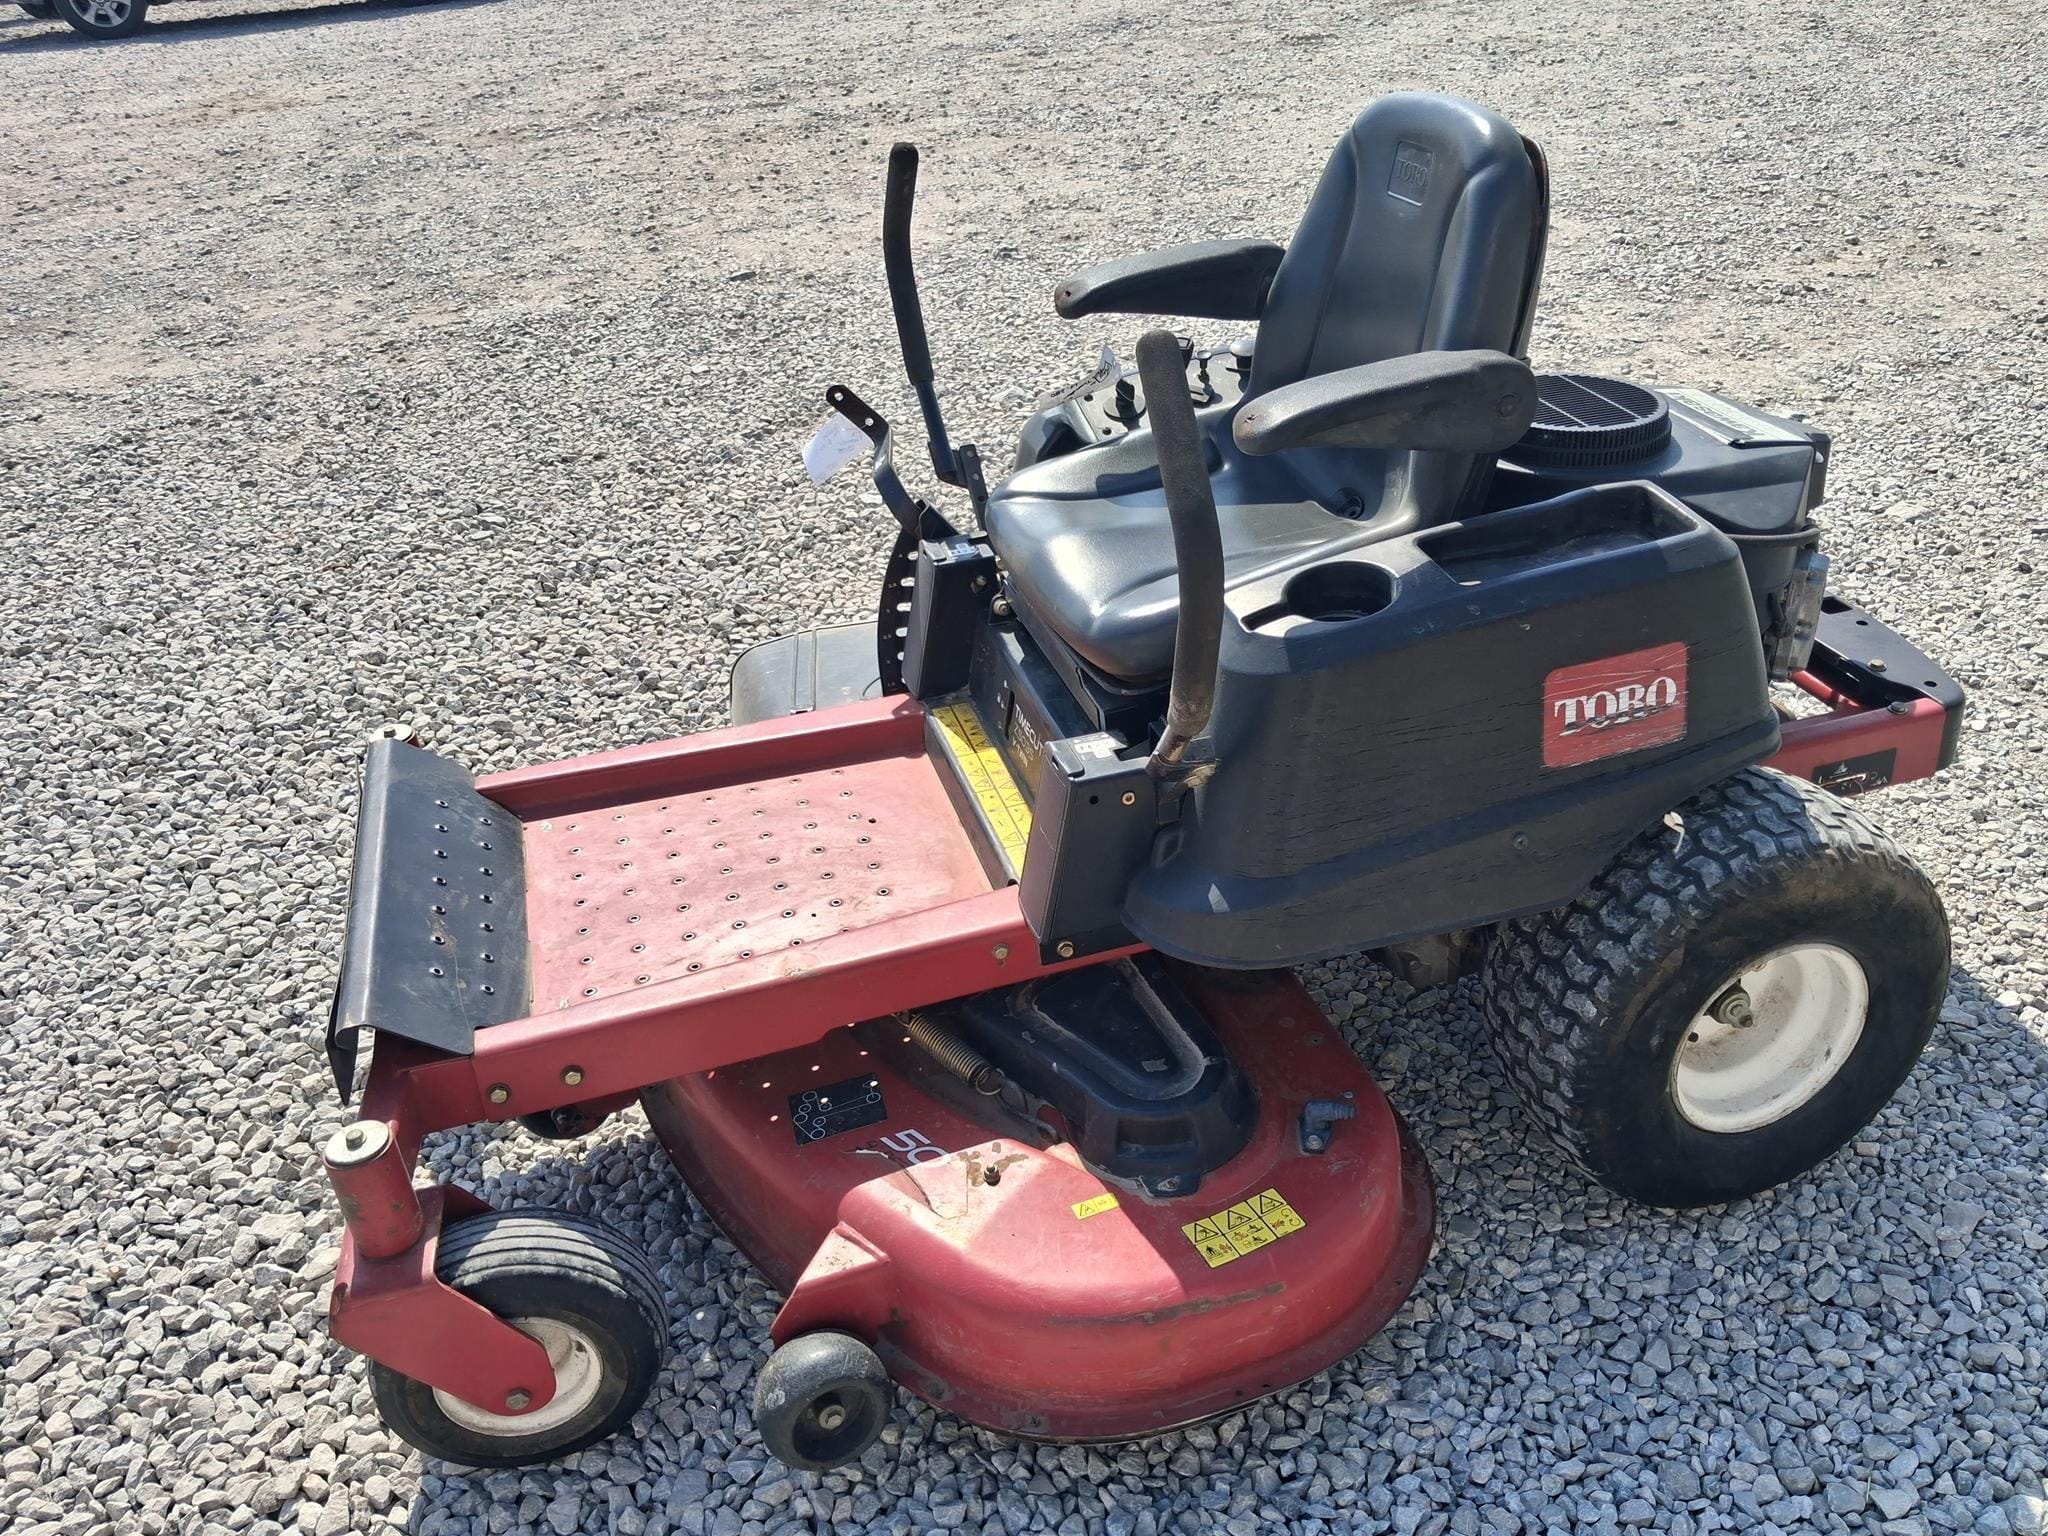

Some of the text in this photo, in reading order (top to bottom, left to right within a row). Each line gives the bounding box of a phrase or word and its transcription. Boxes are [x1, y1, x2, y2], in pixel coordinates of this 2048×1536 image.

[1398, 159, 1428, 187] TORO
[1554, 676, 1677, 736] TORO
[879, 1128, 952, 1168] 50
